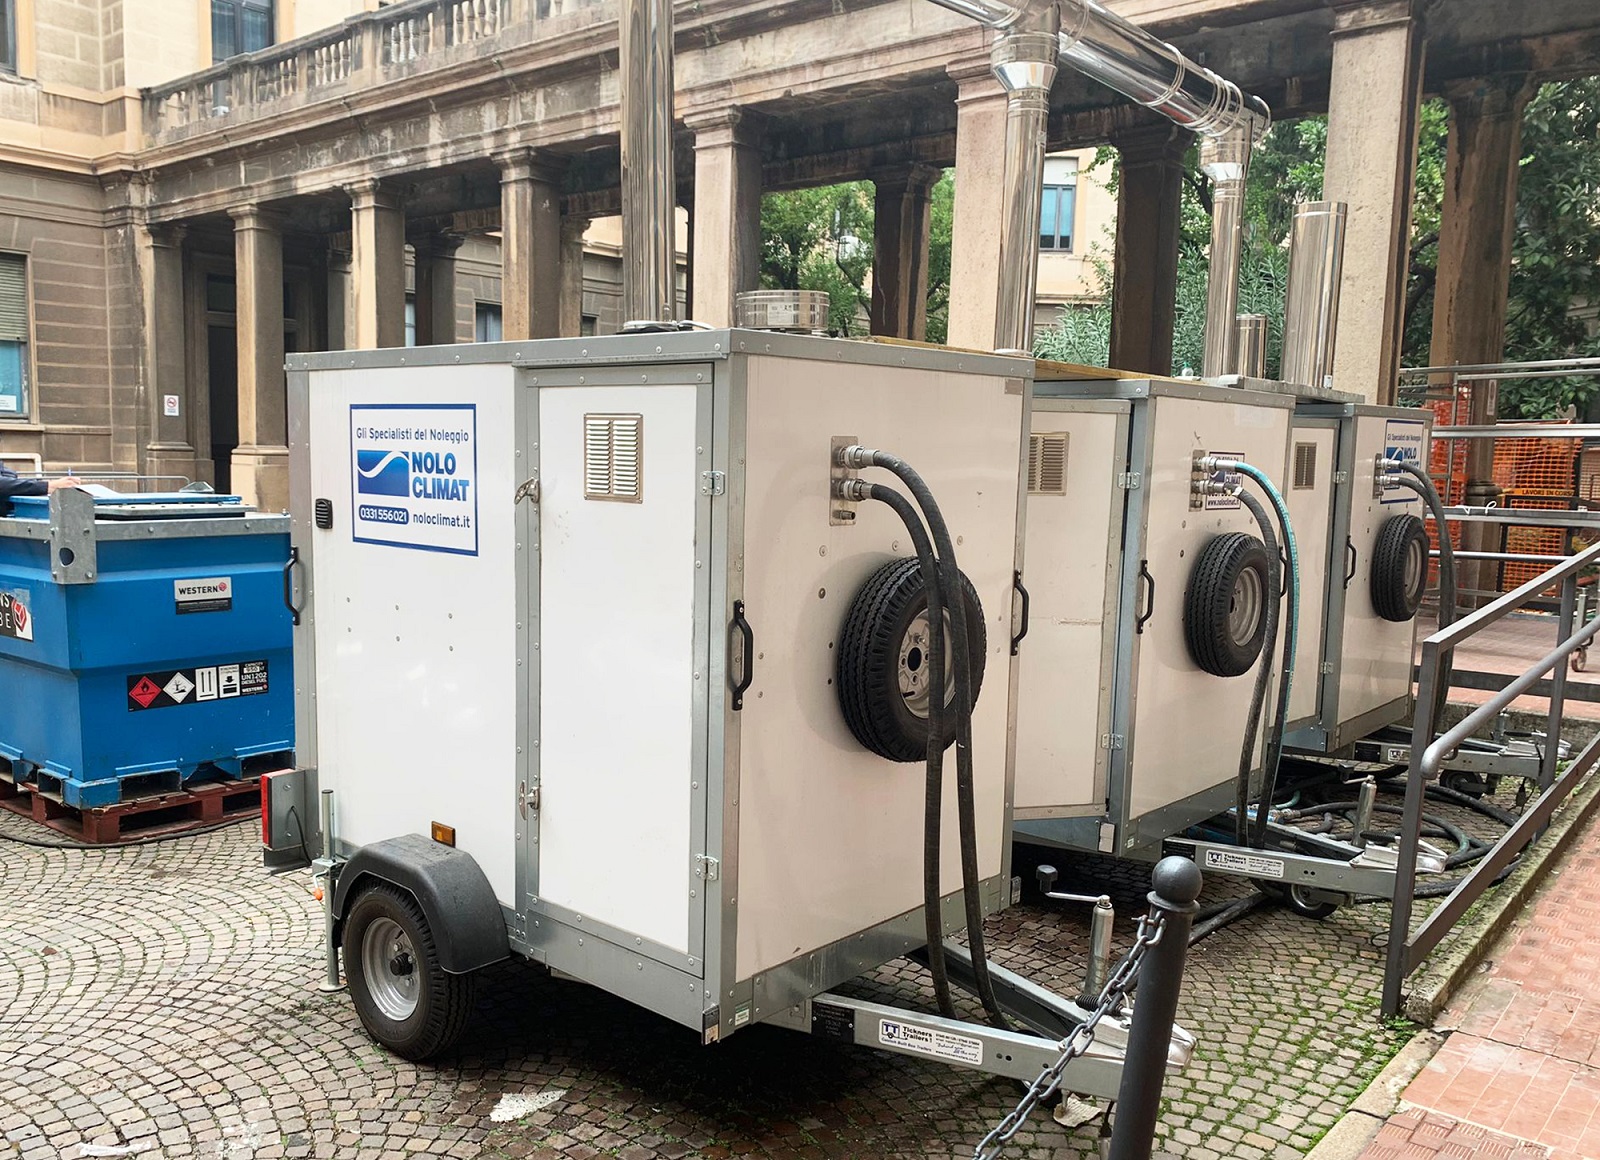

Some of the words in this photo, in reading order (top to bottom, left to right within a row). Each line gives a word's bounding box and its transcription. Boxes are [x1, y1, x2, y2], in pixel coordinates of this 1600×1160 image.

[356, 428, 367, 439] Gli
[369, 428, 412, 442] Specialisti
[415, 428, 428, 440] del
[430, 429, 469, 444] Noleggio
[1404, 447, 1417, 460] NOLO
[412, 452, 457, 476] NOLO
[412, 476, 470, 502] CLIMAT
[360, 508, 406, 522] 0331556021
[413, 512, 470, 528] noloclimat.it
[178, 585, 218, 595] WESTERN
[902, 1026, 932, 1038] Tickners
